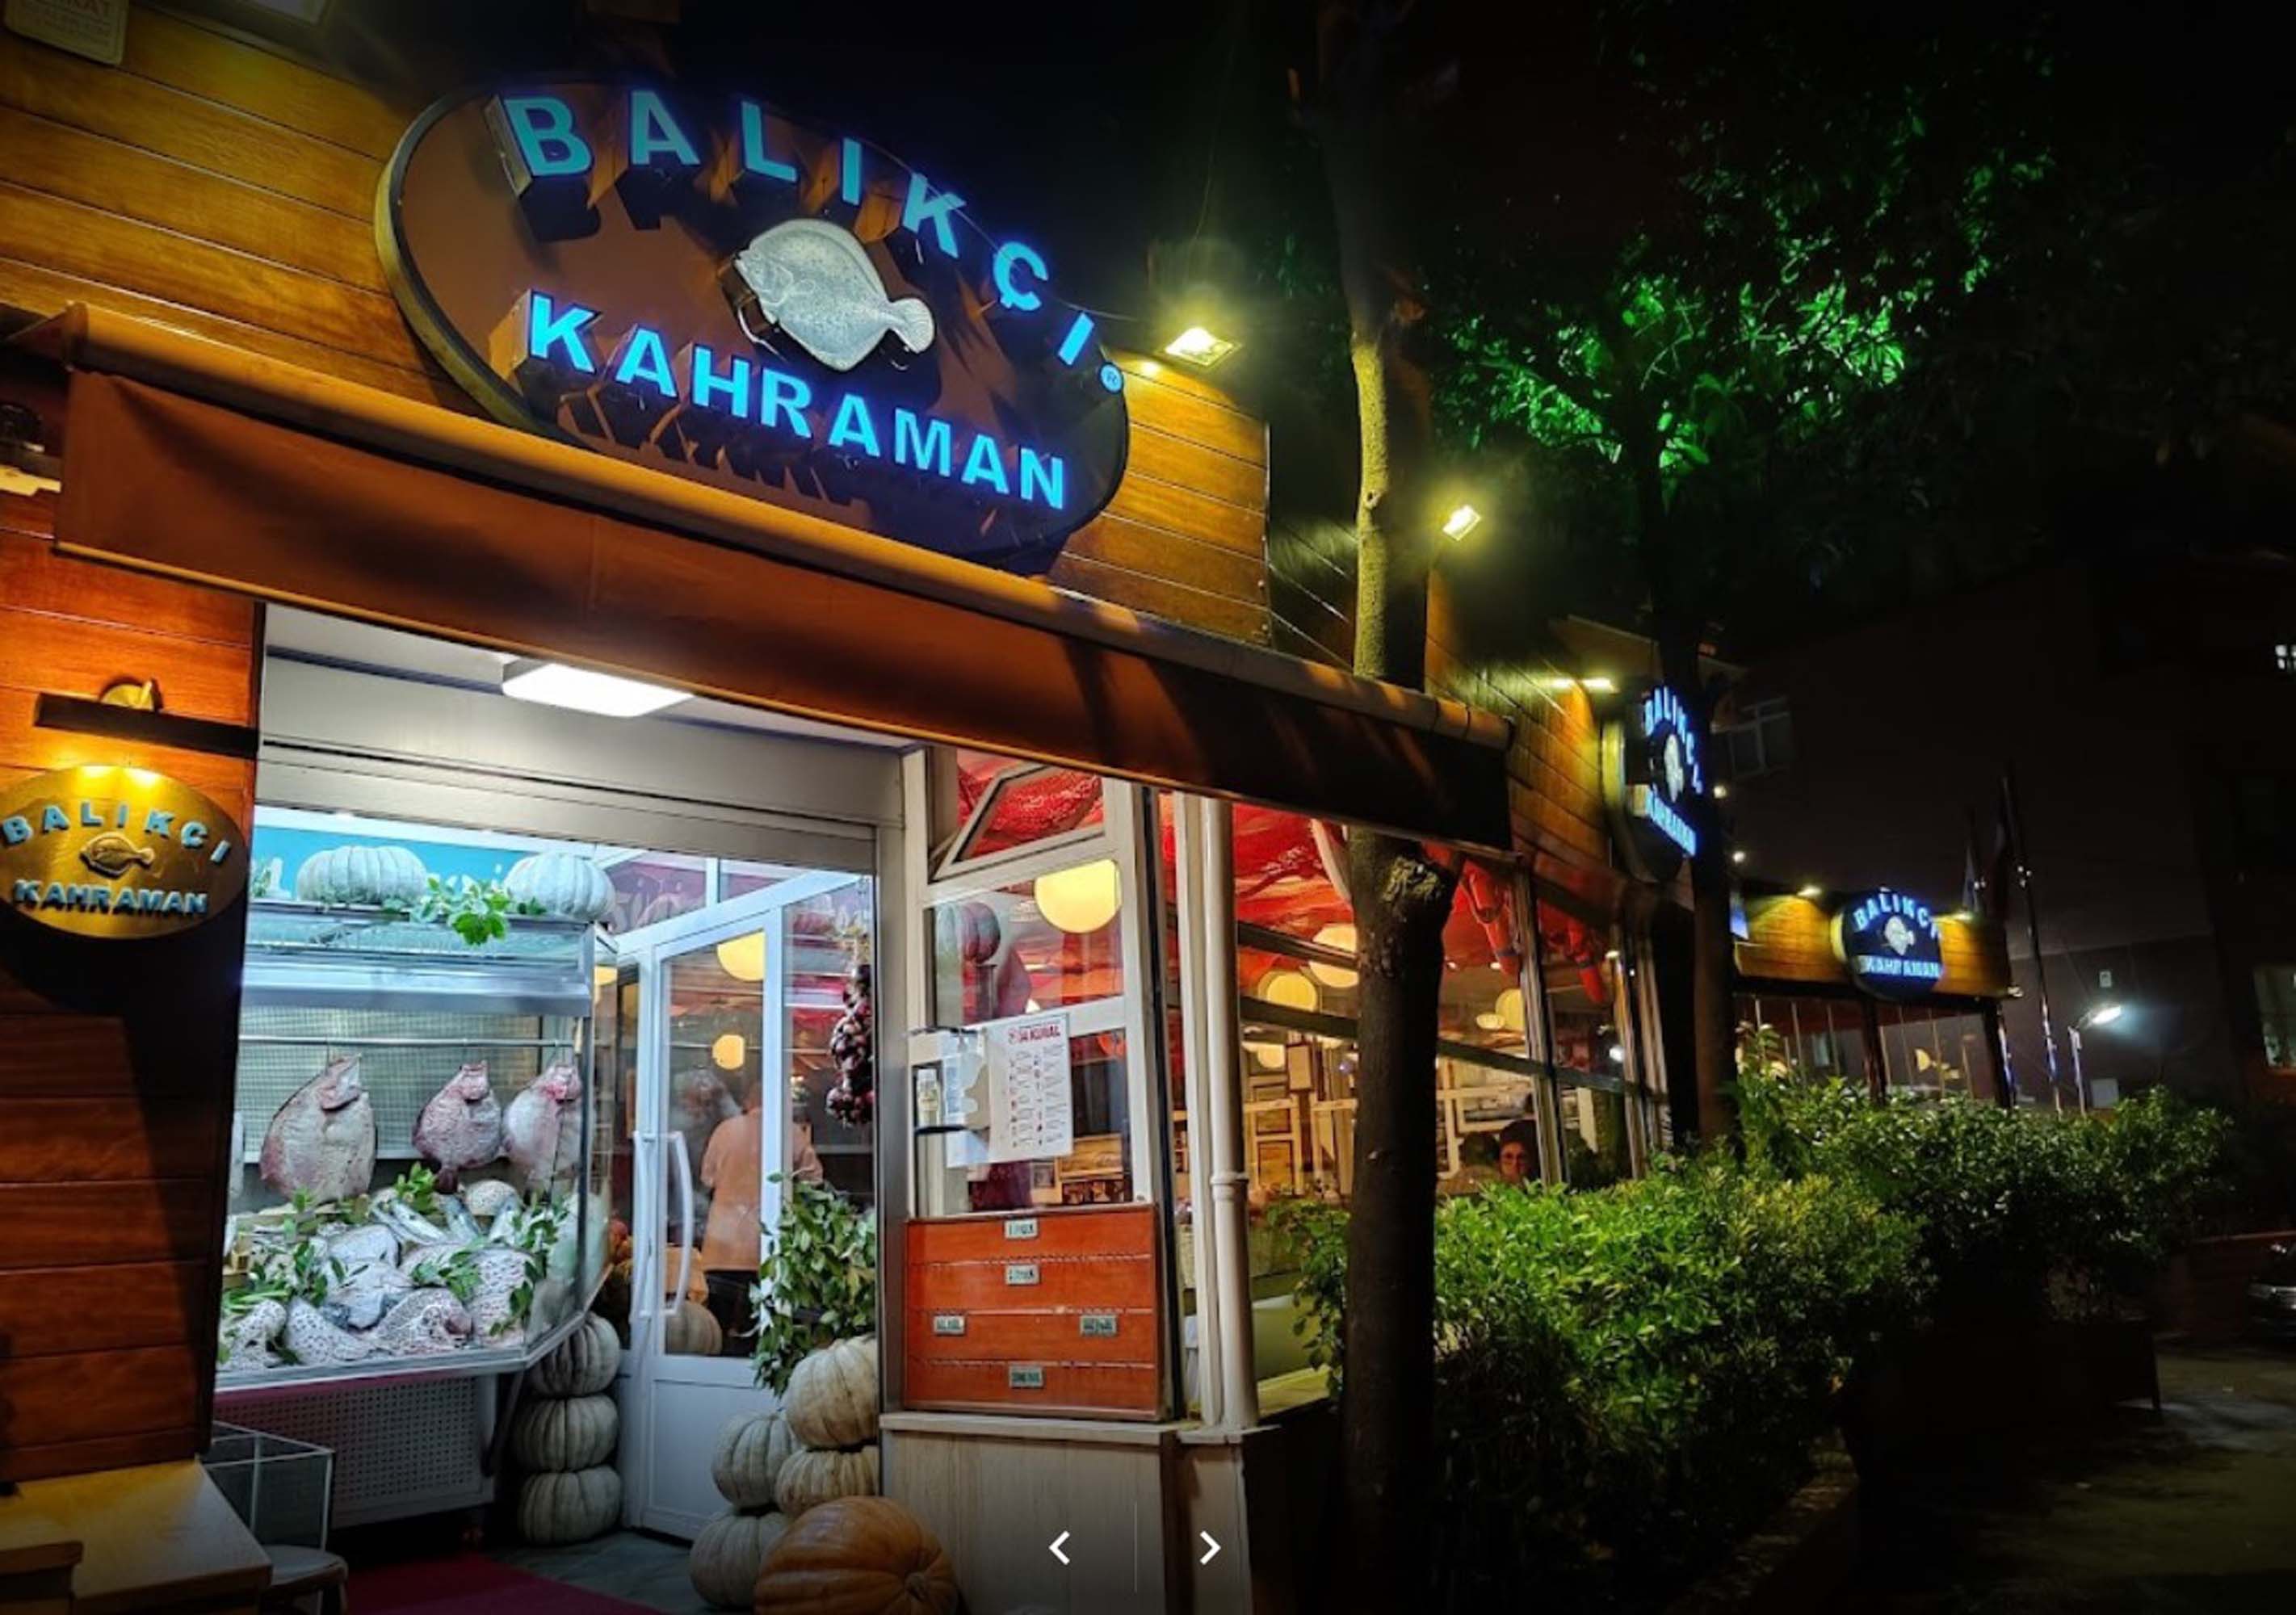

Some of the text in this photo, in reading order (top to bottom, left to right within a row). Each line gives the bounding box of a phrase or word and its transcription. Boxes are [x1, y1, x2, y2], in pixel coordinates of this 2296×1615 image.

[501, 89, 1097, 367] BALIKÇI
[527, 293, 1067, 512] KAHRAMAN
[14, 879, 208, 914] KAHRAMAN
